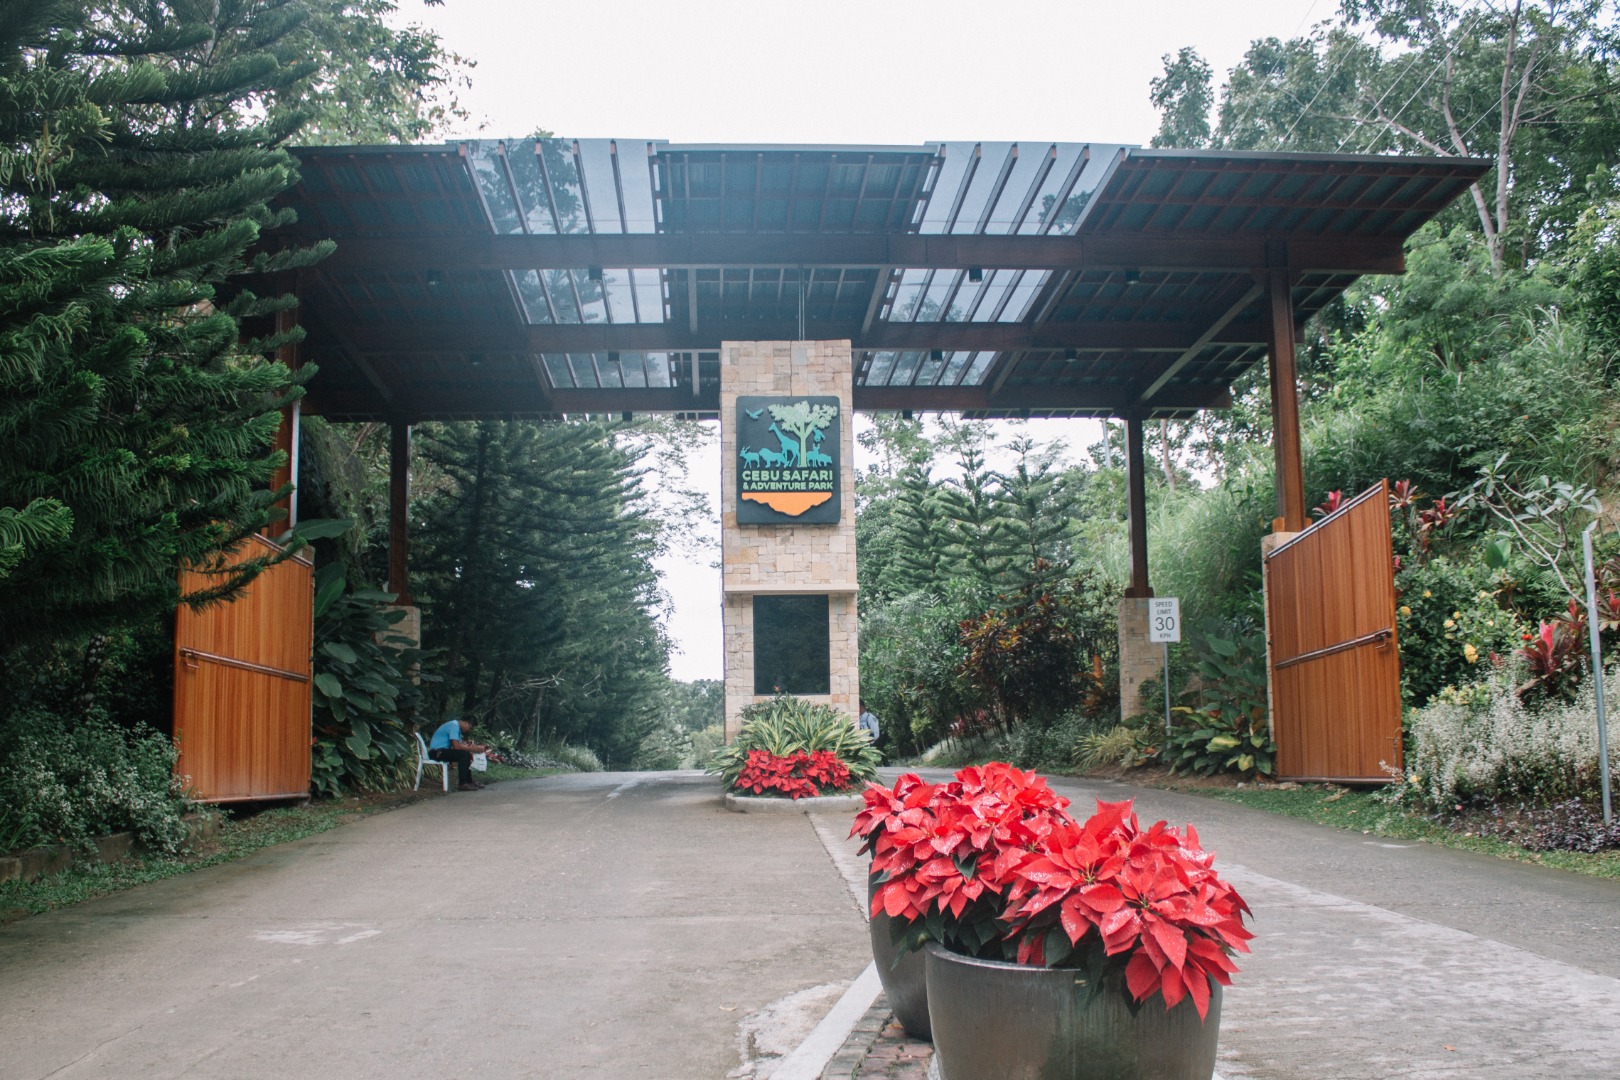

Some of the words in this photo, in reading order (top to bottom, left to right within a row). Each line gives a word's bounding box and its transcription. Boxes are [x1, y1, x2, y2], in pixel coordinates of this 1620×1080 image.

[742, 470, 780, 481] CEBU
[782, 470, 833, 481] SAFARI
[742, 482, 749, 490] &
[750, 482, 807, 490] ADVENTURE
[808, 482, 833, 490] PARK
[1155, 616, 1175, 631] 30
